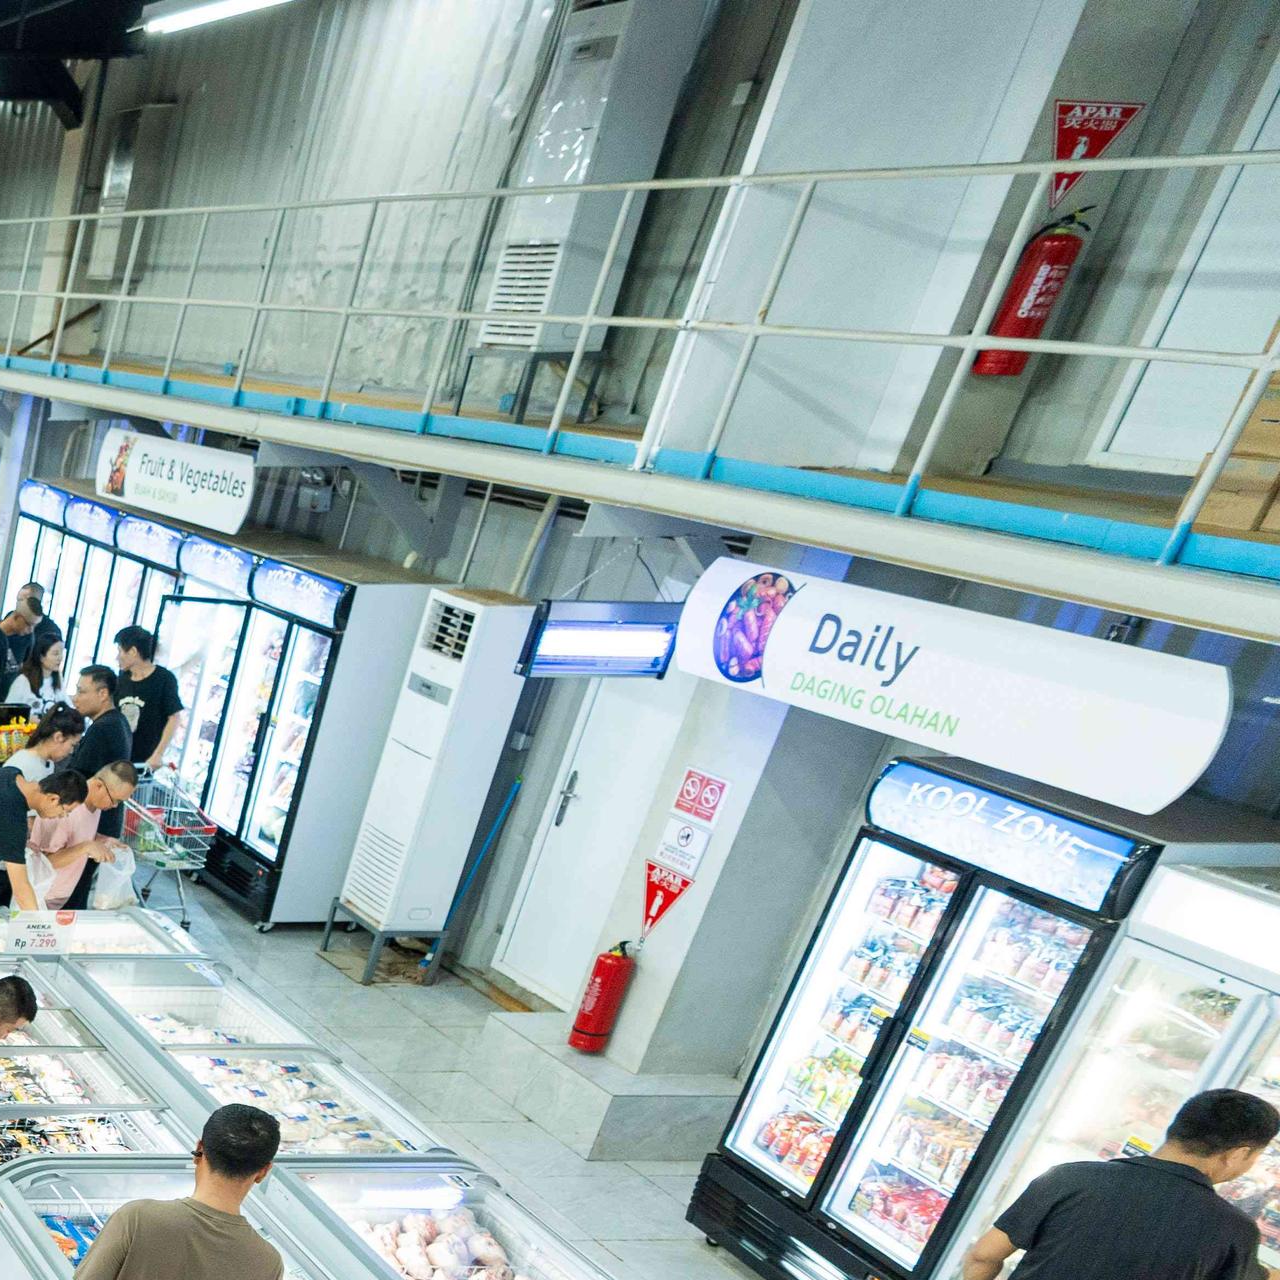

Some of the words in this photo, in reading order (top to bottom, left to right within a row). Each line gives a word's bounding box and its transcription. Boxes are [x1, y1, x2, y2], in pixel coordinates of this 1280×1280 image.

[1068, 105, 1122, 119] APAR
[139, 453, 165, 477] Fruit
[167, 464, 175, 479] &
[178, 462, 247, 499] Vegetables
[808, 613, 921, 687] Daily
[789, 671, 865, 711] DAGING
[869, 695, 960, 737] OLAHAN
[904, 781, 989, 825] KOOL
[992, 804, 1090, 866] ZONE
[652, 865, 684, 885] APAR
[15, 938, 27, 949] Rp
[30, 938, 57, 948] 7.290
